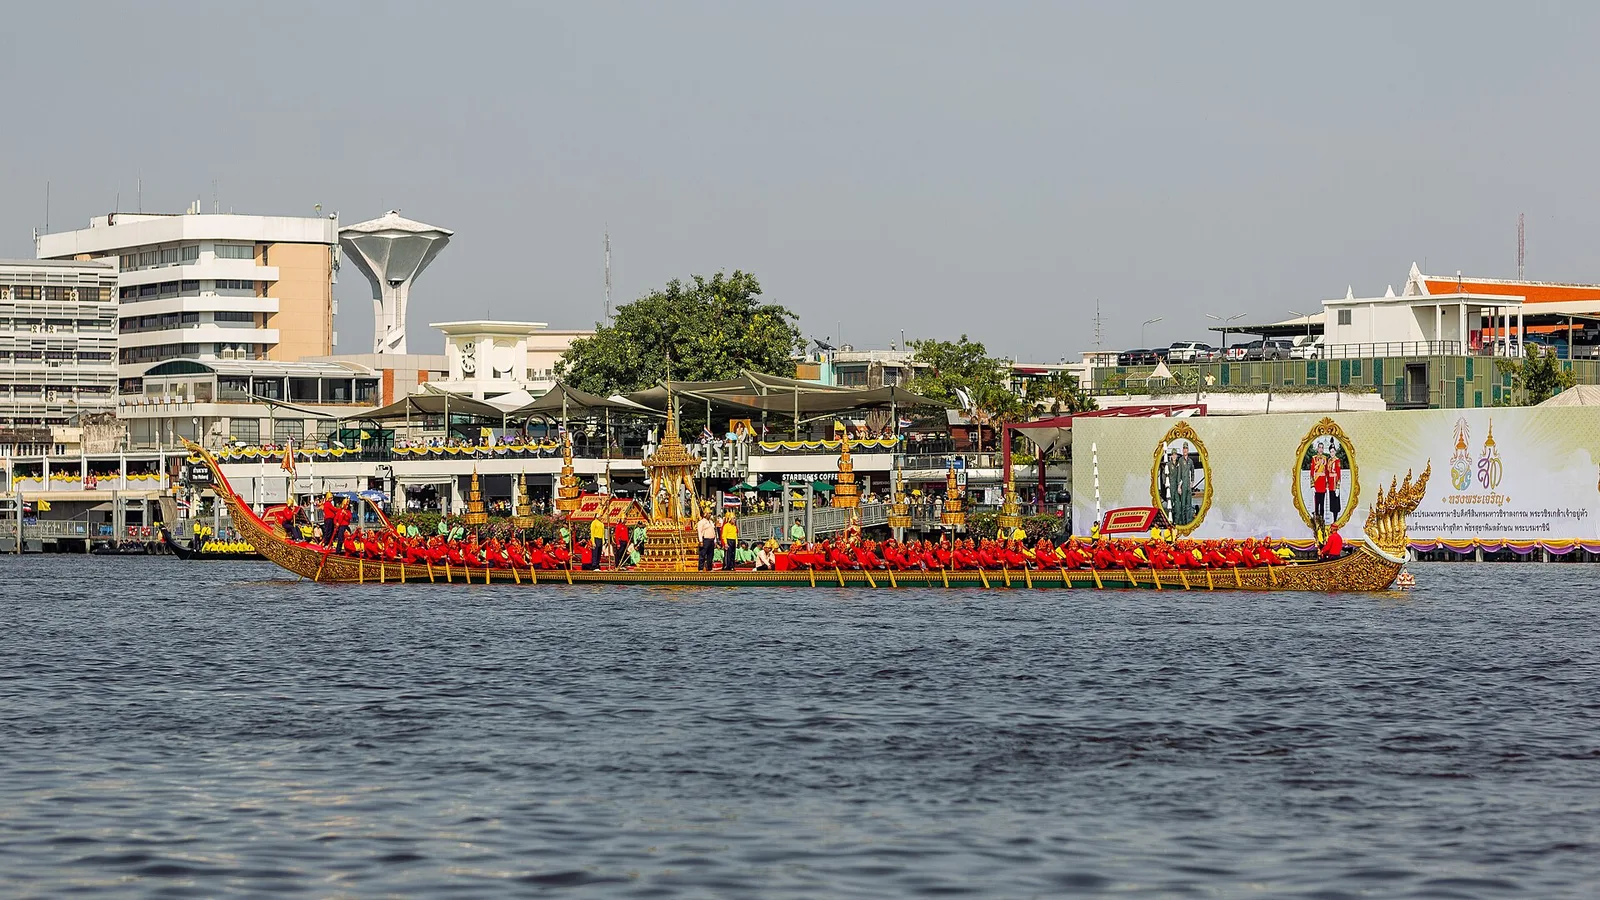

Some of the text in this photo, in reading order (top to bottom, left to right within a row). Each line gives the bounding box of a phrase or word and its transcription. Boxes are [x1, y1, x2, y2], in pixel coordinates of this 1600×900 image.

[691, 466, 748, 478] AHARAJ
[782, 473, 839, 481] STARBUCKS COFFE
[1448, 491, 1505, 507] ทรงพระเจริญ
[1514, 522, 1550, 532] พระบรมราชินี
